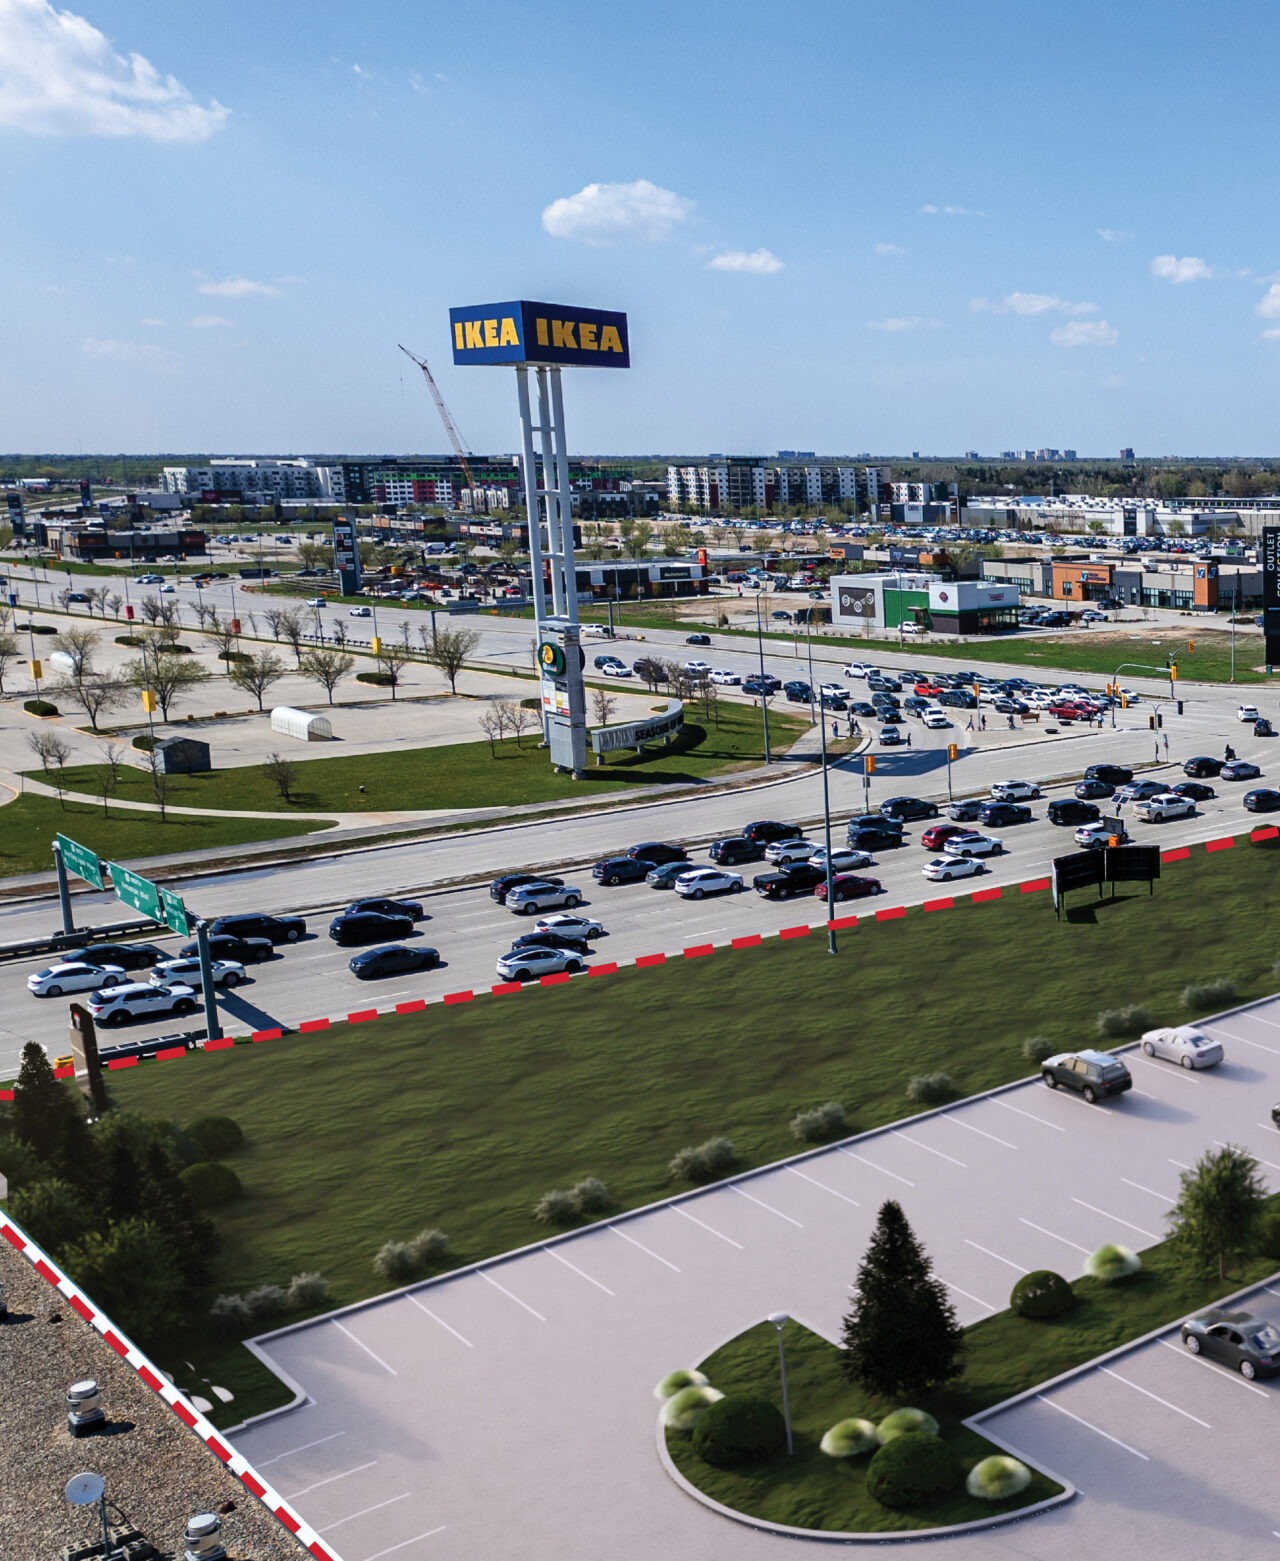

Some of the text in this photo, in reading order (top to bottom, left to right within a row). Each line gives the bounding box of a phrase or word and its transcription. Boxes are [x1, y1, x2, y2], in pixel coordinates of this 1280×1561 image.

[454, 317, 520, 350] IKEA
[536, 317, 624, 353] IKEA
[1266, 533, 1275, 571] OUTLET
[635, 721, 669, 741] SEASONS
